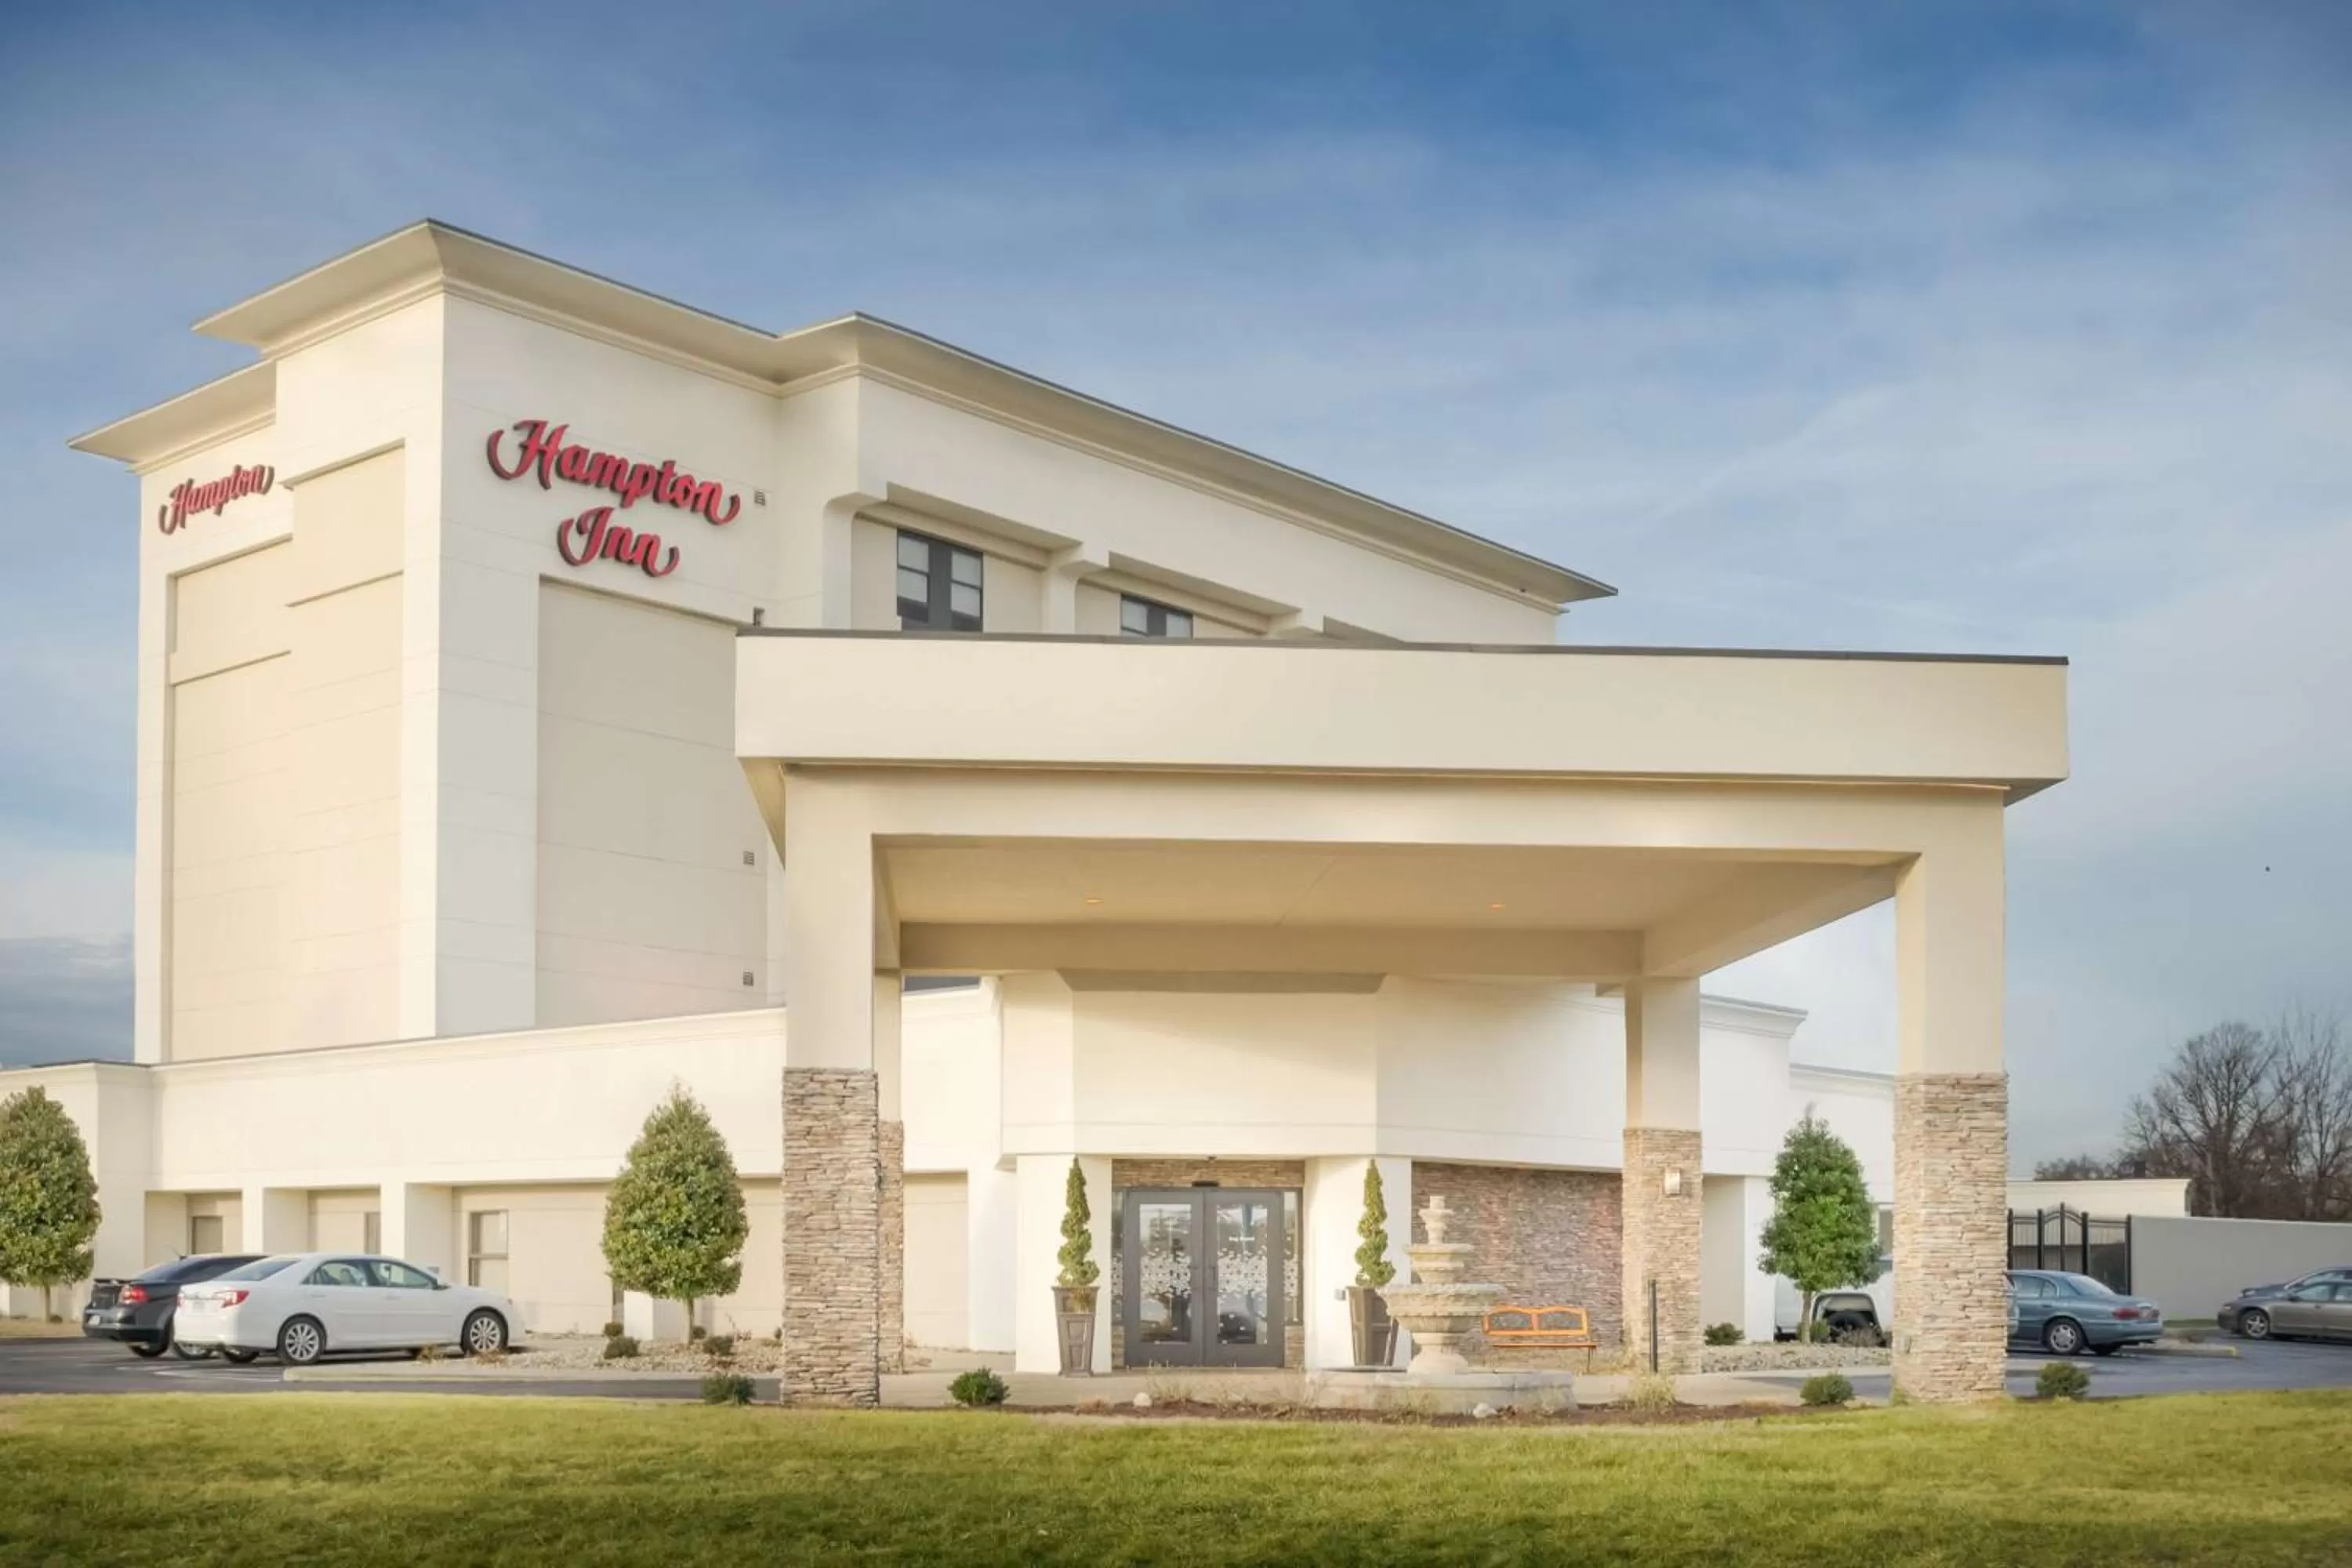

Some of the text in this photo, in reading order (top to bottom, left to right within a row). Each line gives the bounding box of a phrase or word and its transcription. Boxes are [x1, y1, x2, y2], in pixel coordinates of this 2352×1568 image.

[159, 464, 274, 535] Hampton
[487, 419, 741, 526] Hampton
[557, 506, 680, 577] Inn
